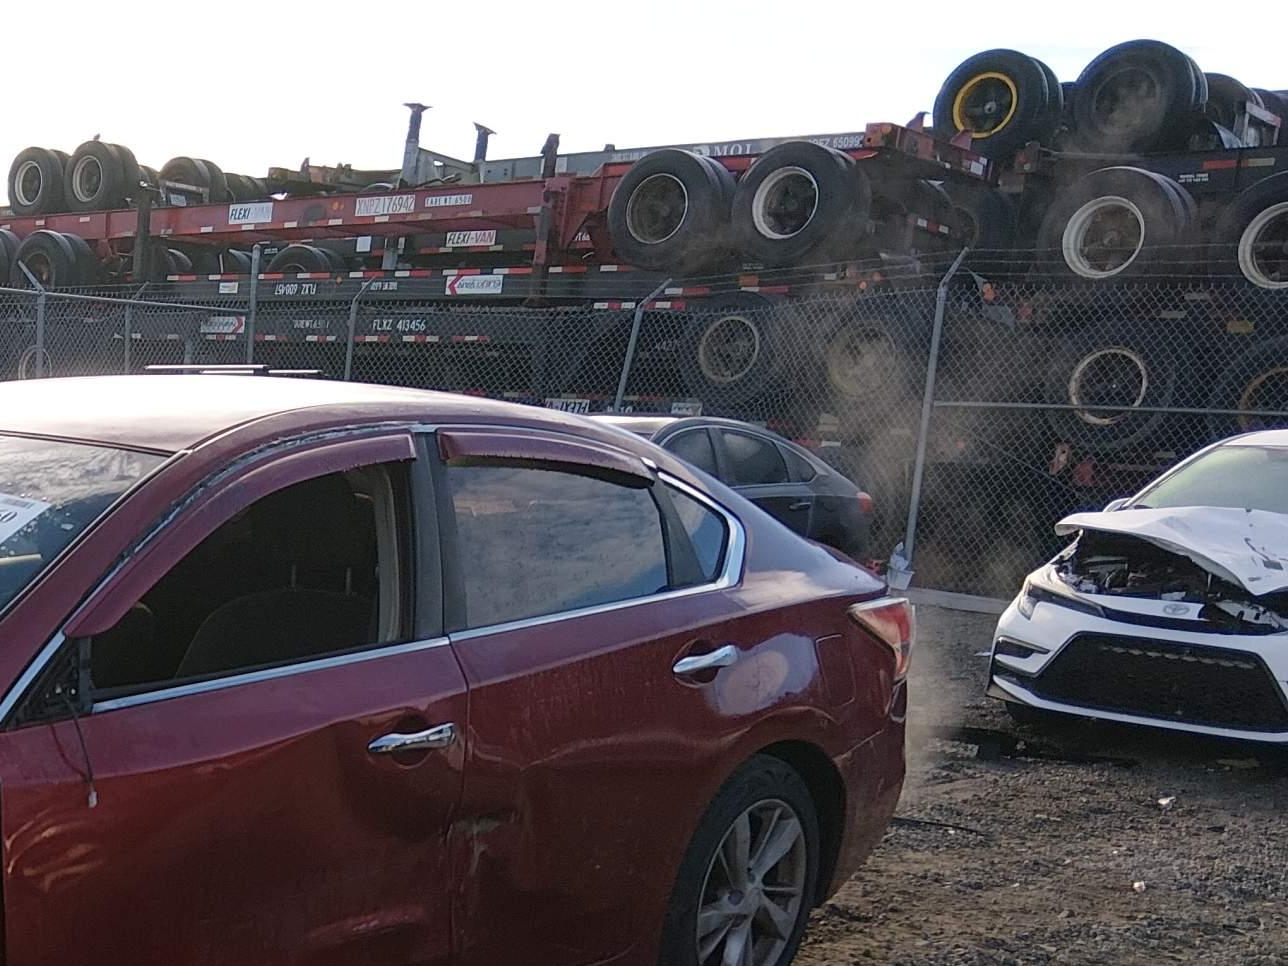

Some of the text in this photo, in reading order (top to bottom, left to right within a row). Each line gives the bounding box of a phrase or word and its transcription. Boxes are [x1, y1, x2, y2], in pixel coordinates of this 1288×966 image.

[448, 231, 496, 246] FLEXI-VAN
[372, 319, 426, 332] FLXZ 413456
